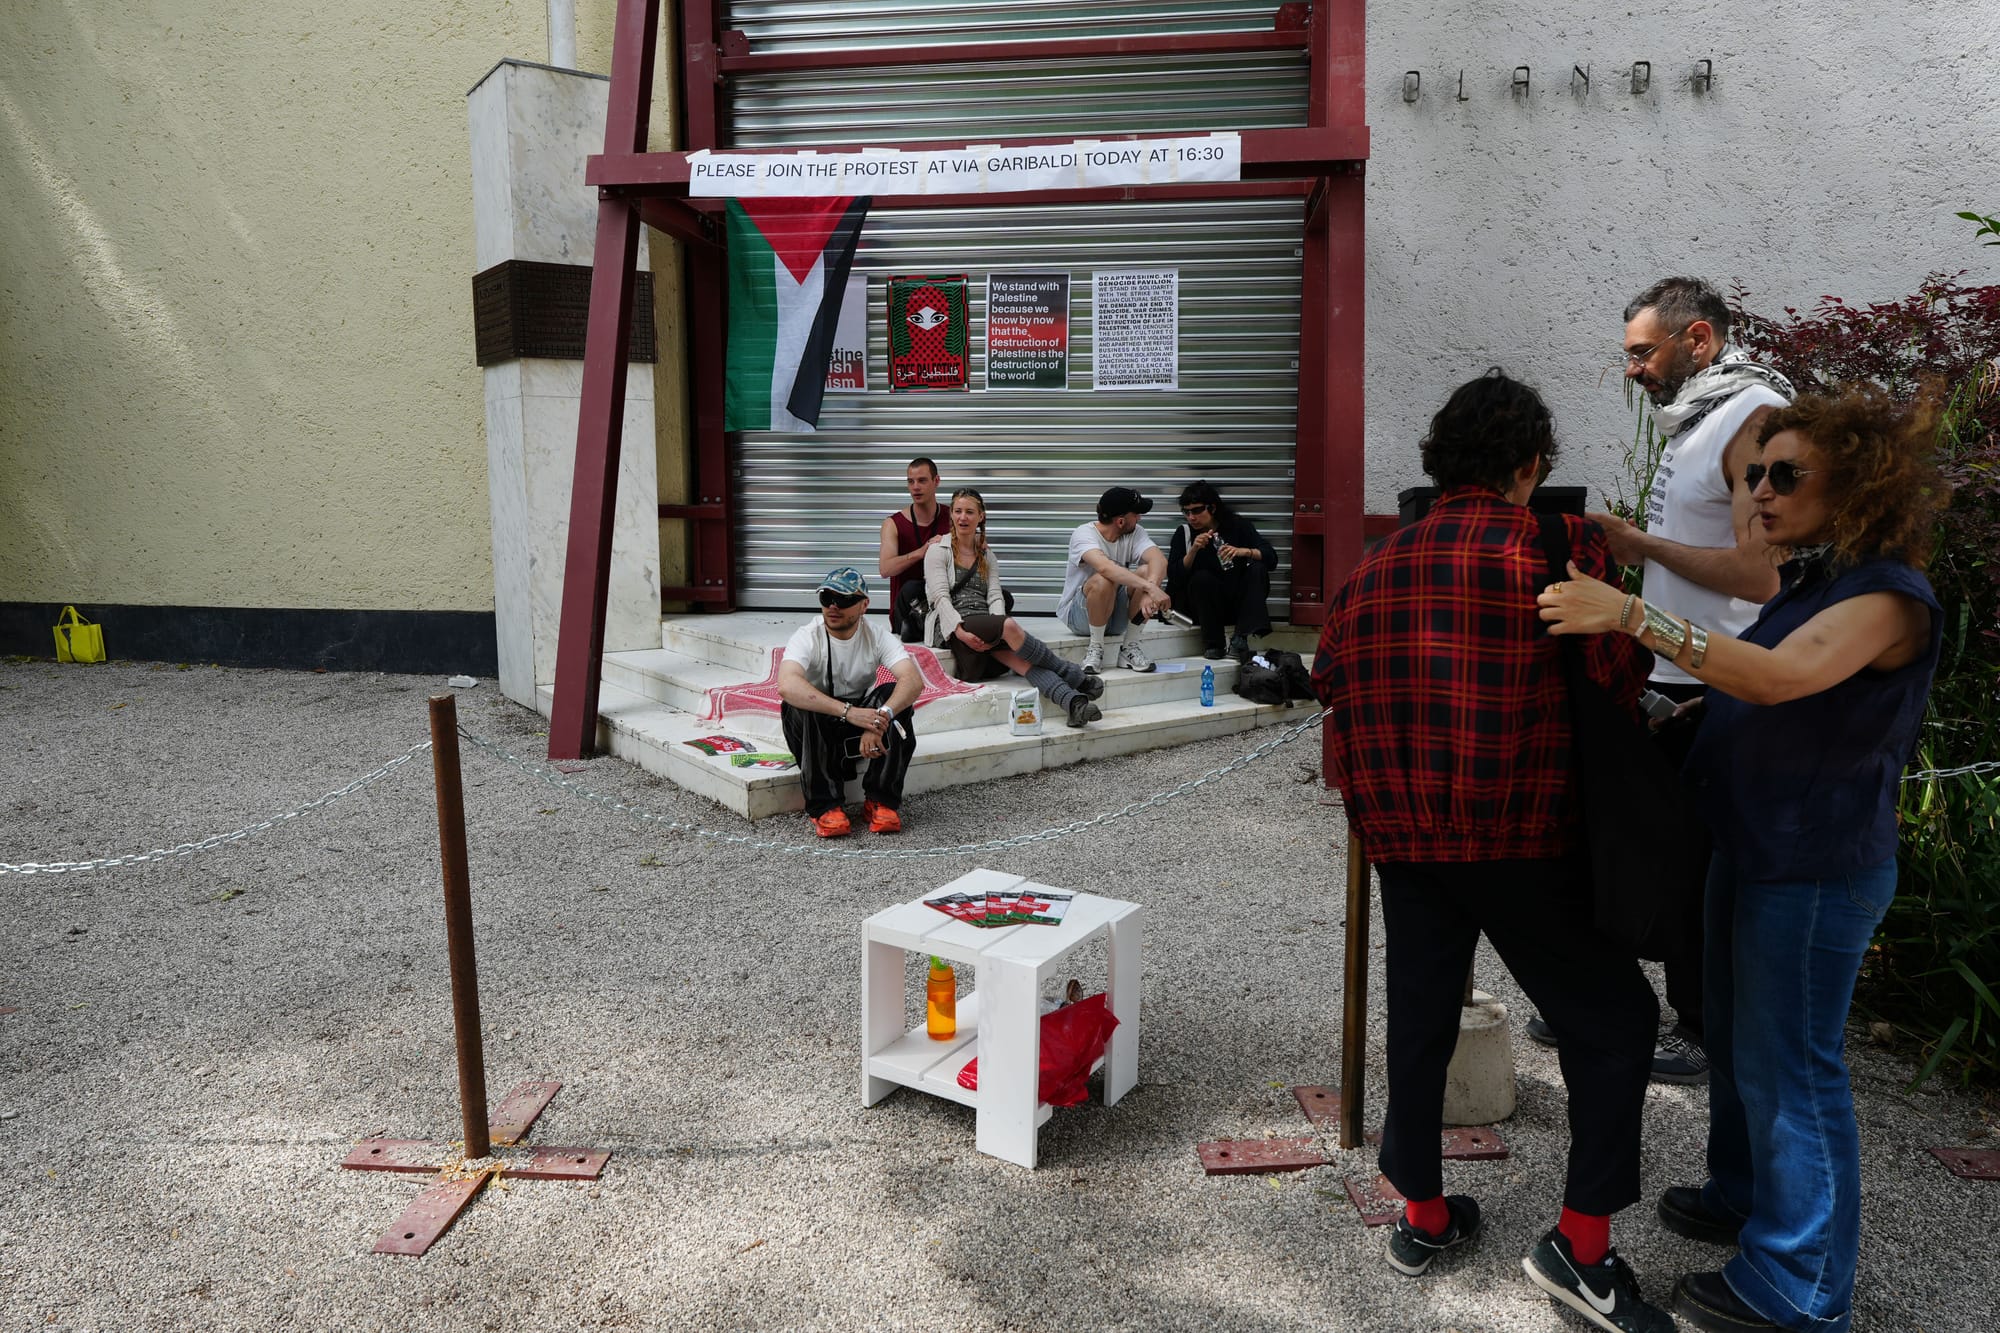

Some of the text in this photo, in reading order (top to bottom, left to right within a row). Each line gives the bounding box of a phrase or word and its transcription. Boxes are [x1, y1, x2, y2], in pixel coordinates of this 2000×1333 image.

[1402, 60, 1713, 102] OLANDA
[696, 147, 1224, 177] PLEASE JOIN THE PROTEST AT VIA GARIBALDI TODAY AT 16:30
[992, 282, 1060, 291] We stand with
[992, 293, 1038, 302] Palestine
[992, 304, 1033, 313] because
[992, 316, 1018, 324] know
[1020, 316, 1032, 326] by
[1012, 327, 1027, 335] the
[991, 338, 1059, 347] destruction of
[992, 349, 1064, 358] Palestine is the
[990, 360, 1059, 369] destruction of
[897, 366, 958, 380] فلسطين حرة
[990, 371, 1036, 380] the world
